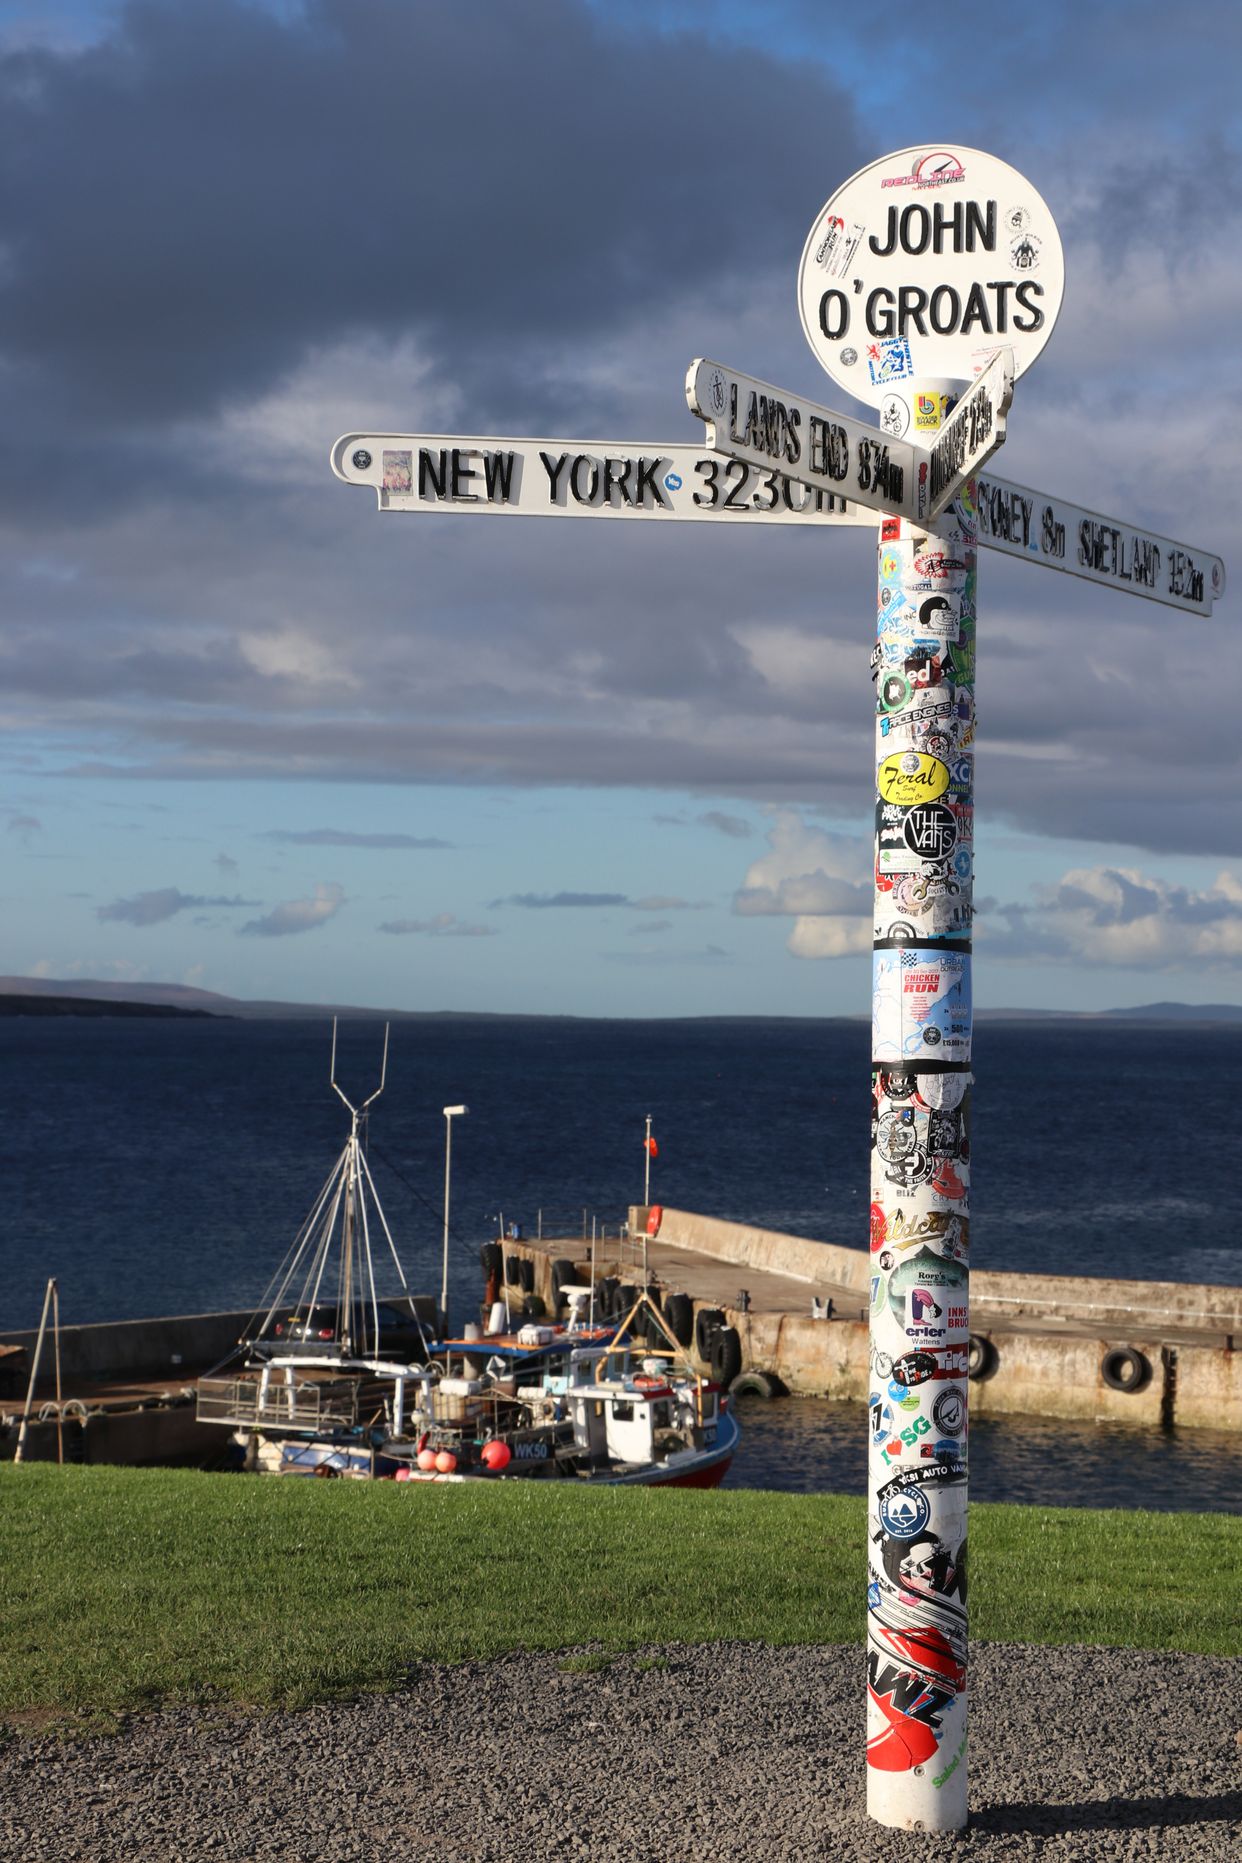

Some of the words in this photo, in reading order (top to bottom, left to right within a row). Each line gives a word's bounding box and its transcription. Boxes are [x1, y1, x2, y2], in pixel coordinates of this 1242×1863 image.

[881, 168, 966, 189] REDLINE
[868, 200, 995, 256] JOHN
[818, 280, 1045, 340] O'GROATS
[730, 383, 801, 464] LANDS
[809, 415, 849, 481] END
[858, 436, 904, 504] 874m
[418, 447, 515, 505] NEW
[539, 450, 665, 509] YORK
[1042, 505, 1066, 558] 8m
[1078, 519, 1161, 589] SHETLAND
[1168, 548, 1204, 603] 152m
[912, 703, 951, 720] ENGINES
[884, 760, 937, 796] Feral
[913, 811, 944, 829] THE
[908, 819, 953, 853] VANS
[904, 974, 940, 982] CHICKEN
[903, 984, 939, 993] RUN
[918, 1271, 946, 1281] Rory's
[948, 1307, 967, 1318] INNS
[905, 1327, 946, 1338] erler
[900, 1415, 932, 1448] SG
[514, 1443, 547, 1459] WK50
[899, 1472, 919, 1485] YKSI
[922, 1466, 948, 1479] AUTO
